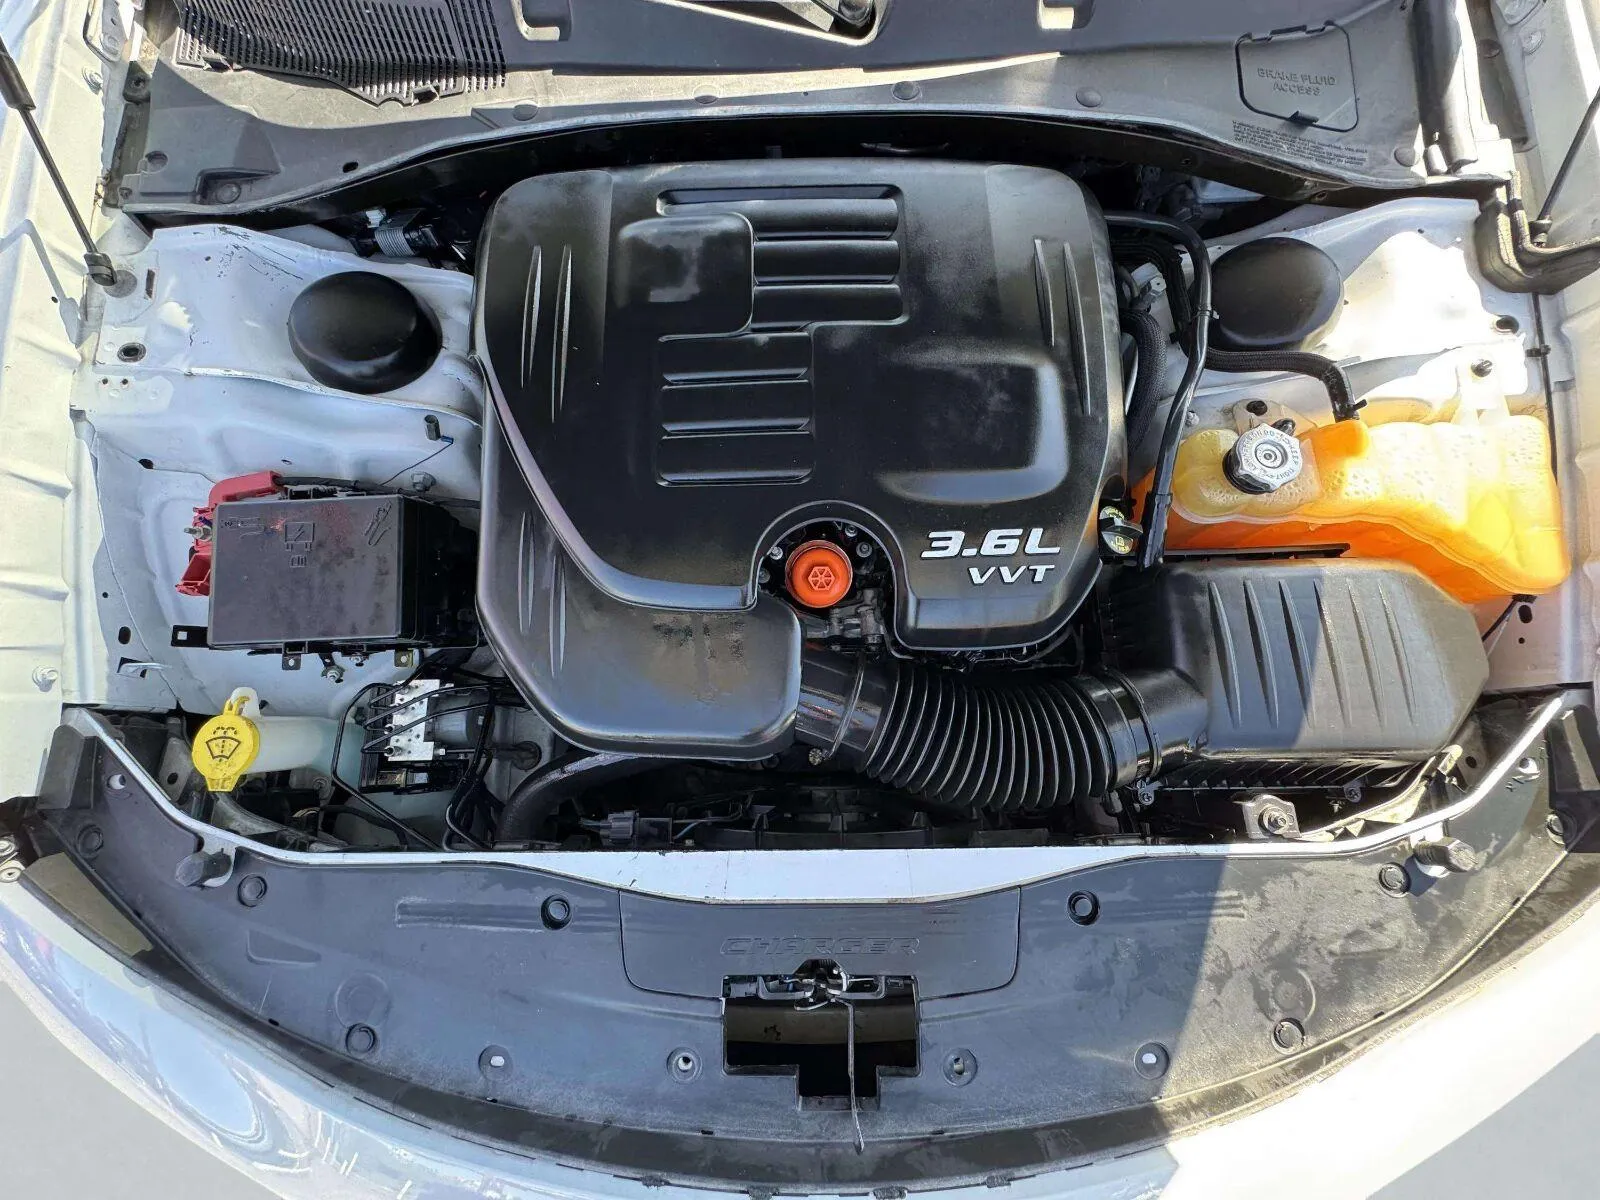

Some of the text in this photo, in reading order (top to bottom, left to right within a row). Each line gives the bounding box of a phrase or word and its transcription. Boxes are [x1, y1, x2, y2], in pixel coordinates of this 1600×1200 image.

[1273, 81, 1321, 96] ACCESS
[1300, 74, 1336, 86] FLUID
[920, 527, 1061, 558] 3.6L
[968, 564, 1056, 584] VVT
[720, 937, 920, 955] CHARGER
